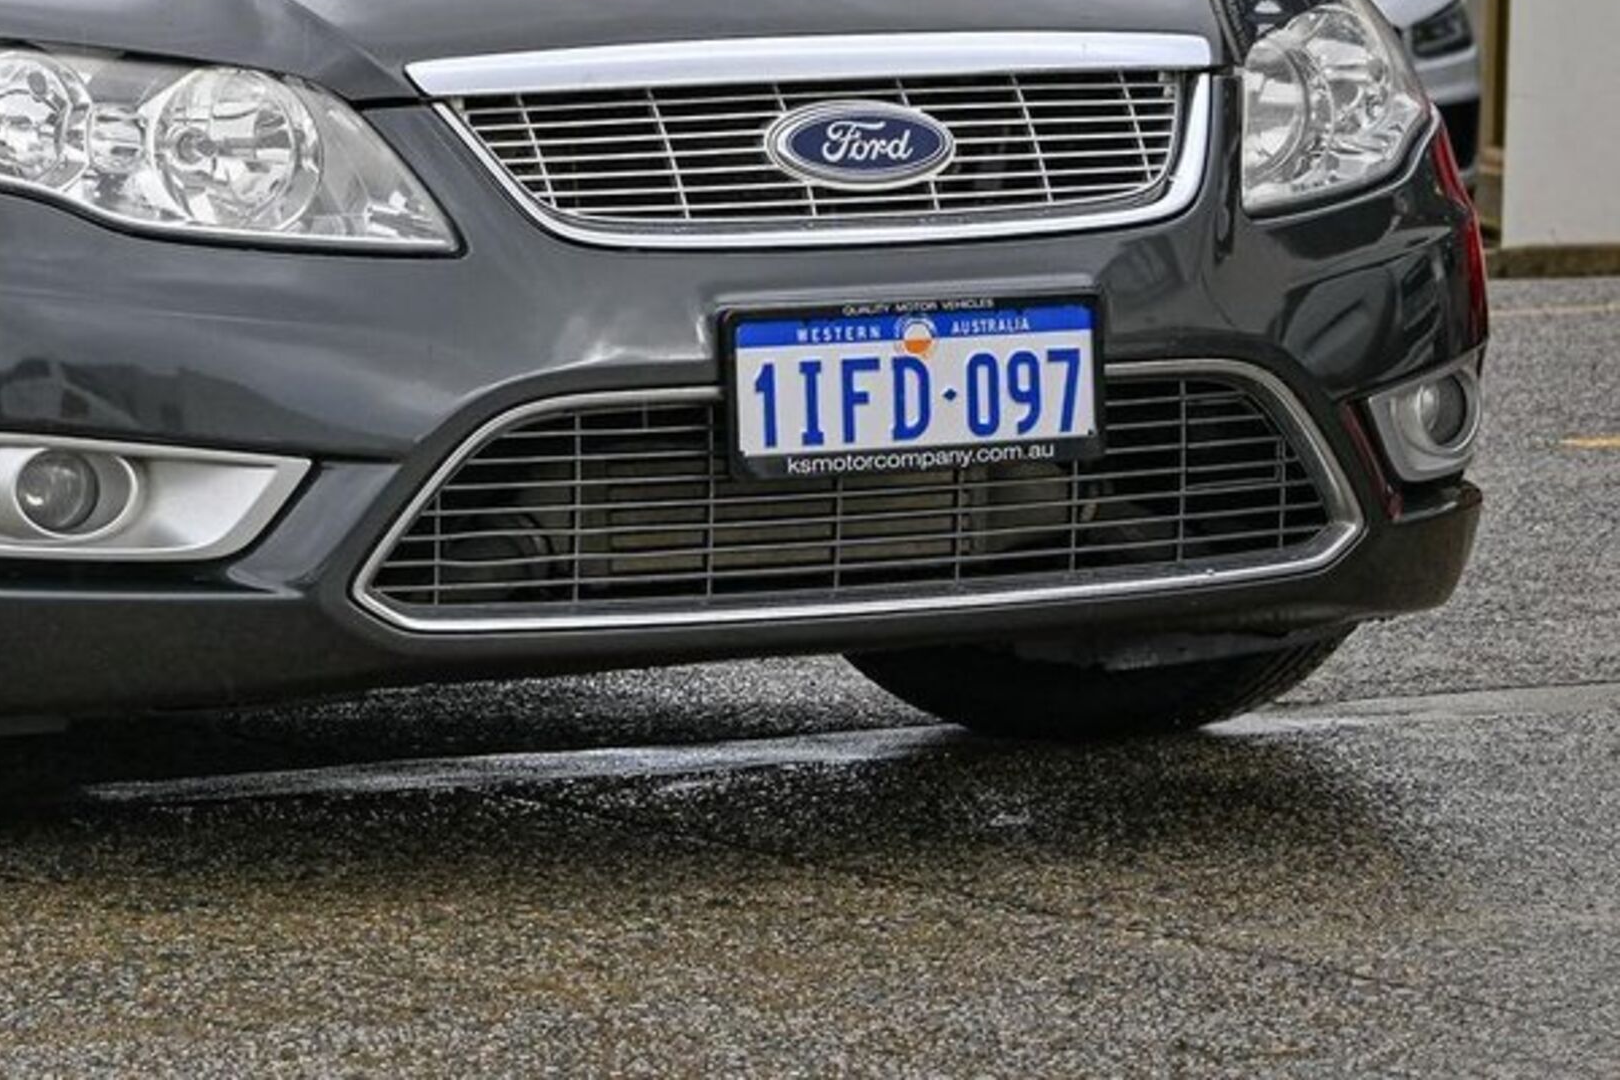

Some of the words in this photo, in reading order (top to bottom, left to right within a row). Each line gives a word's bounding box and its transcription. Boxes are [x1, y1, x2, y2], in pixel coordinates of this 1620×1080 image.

[822, 121, 913, 162] Ford
[842, 304, 890, 317] QUALITY
[895, 301, 940, 312] MOTOR
[942, 298, 994, 310] VEHICLES
[797, 326, 880, 342] WESTERN
[950, 317, 1030, 335] AUSTRALIA
[787, 443, 1055, 474] ksmotorcompany.com.au
